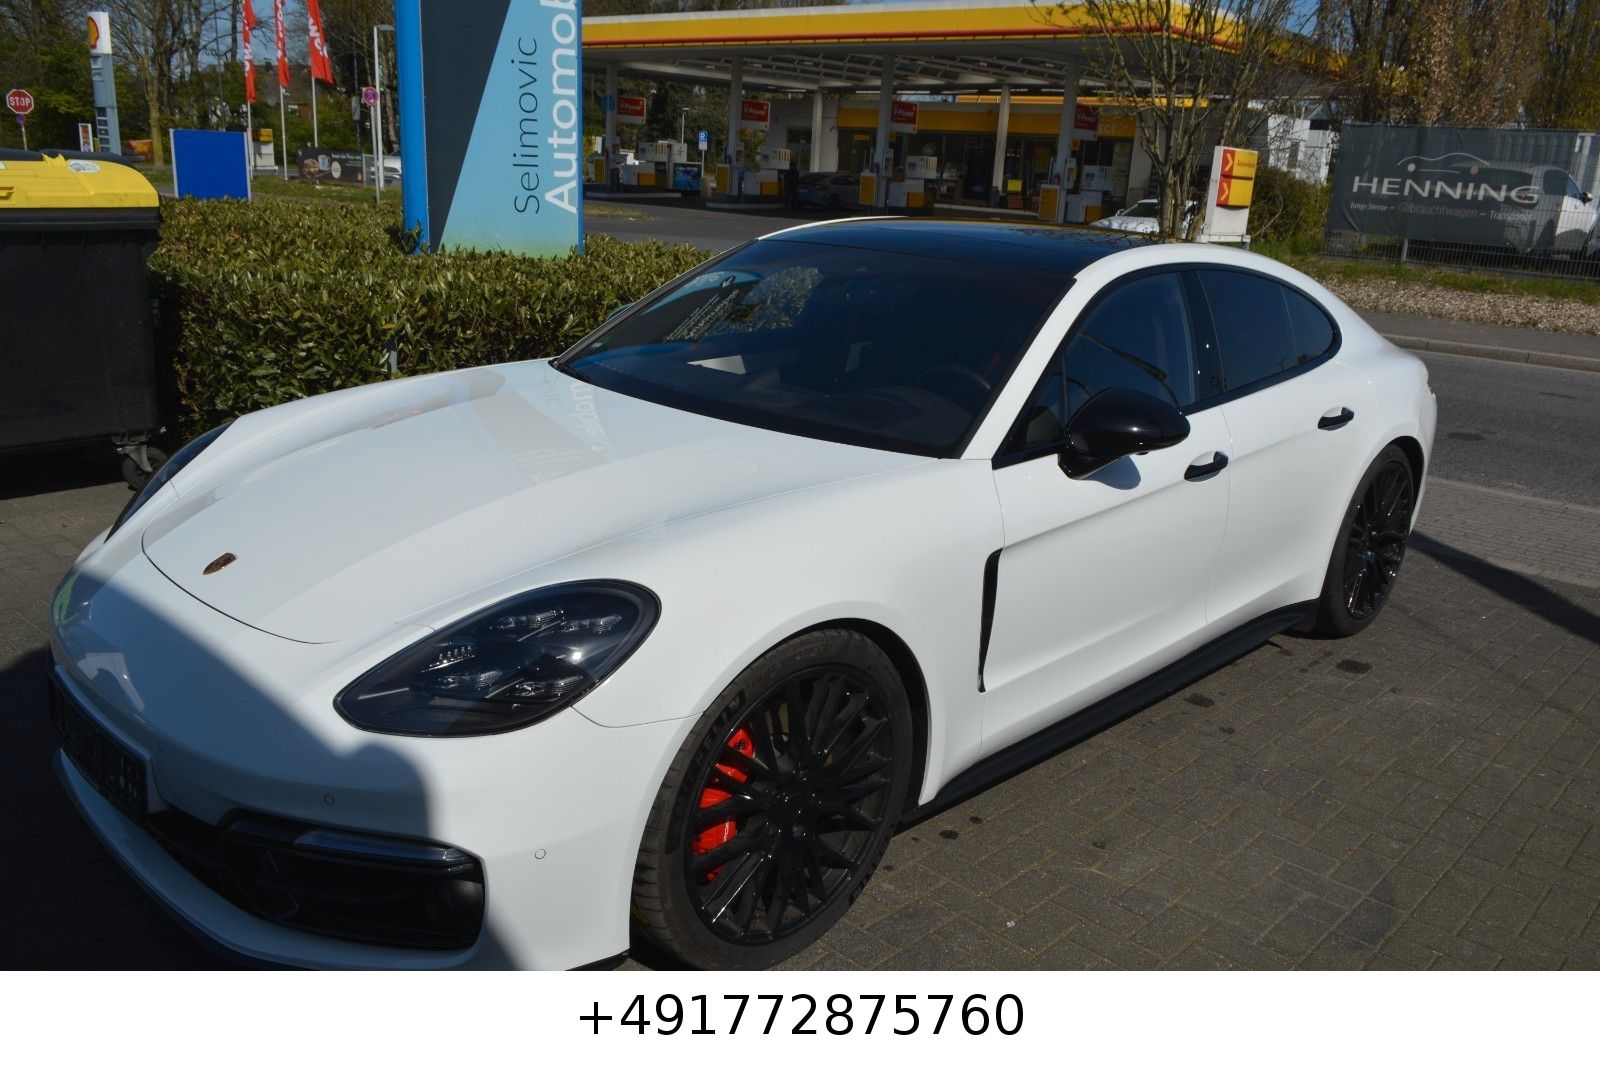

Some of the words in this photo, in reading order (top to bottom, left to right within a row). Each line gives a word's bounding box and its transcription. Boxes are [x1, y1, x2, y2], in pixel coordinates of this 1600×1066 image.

[9, 97, 31, 106] STOP
[511, 37, 540, 214] Selimovic
[1352, 176, 1540, 204] HENNING
[1400, 201, 1477, 218] Gebrauchtwagen
[1490, 210, 1533, 221] Transporter
